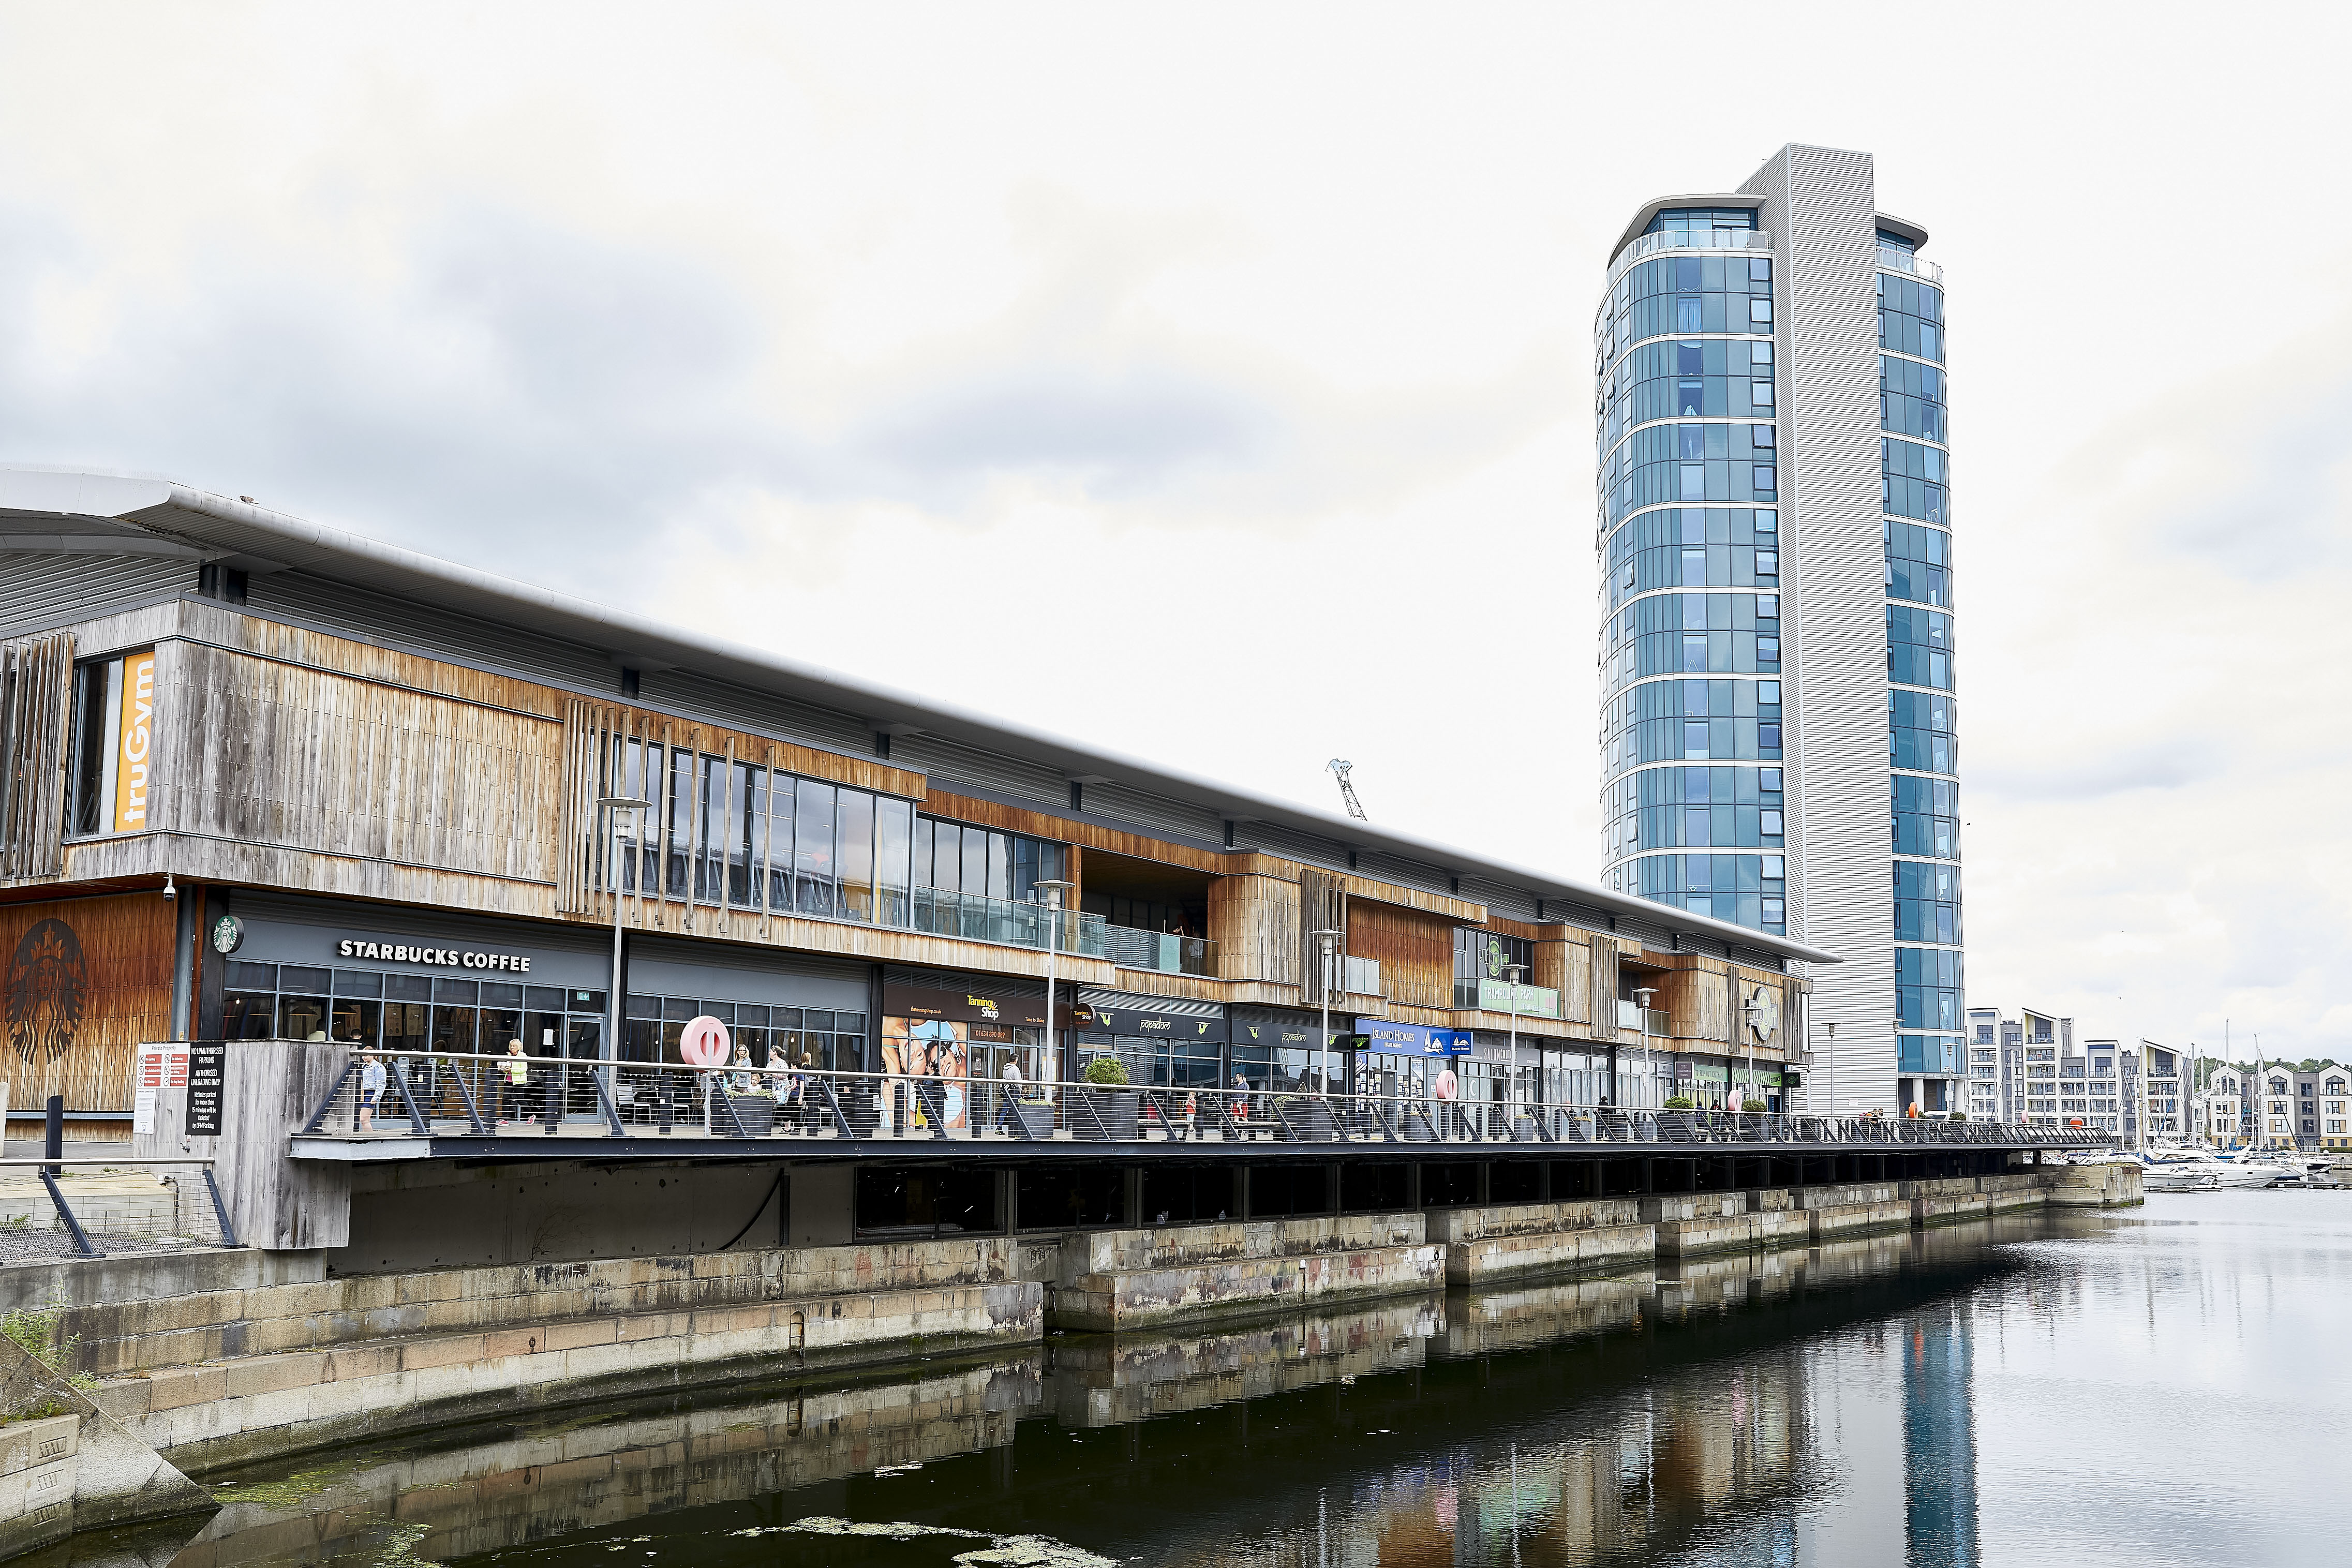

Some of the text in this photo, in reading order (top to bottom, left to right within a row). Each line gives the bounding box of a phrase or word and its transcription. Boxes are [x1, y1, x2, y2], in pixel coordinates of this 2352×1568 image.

[124, 660, 154, 823] truGym
[340, 939, 530, 972] STARBUCKS COFFEE
[1484, 987, 1534, 1000] TRAMPOLINE PARK
[967, 995, 994, 1010] Tanning
[911, 1006, 942, 1014] thetanningshop.co.uk
[981, 1007, 999, 1021] Shop
[1139, 1016, 1171, 1033] popadom
[1281, 1029, 1307, 1044] popadom
[1372, 1027, 1415, 1042] ISLAND HOMES
[197, 1047, 224, 1055] UNAUTHORISED
[199, 1056, 215, 1064] PARKING
[195, 1069, 217, 1077] AUTHORISED
[190, 1078, 211, 1086] UNLOADING
